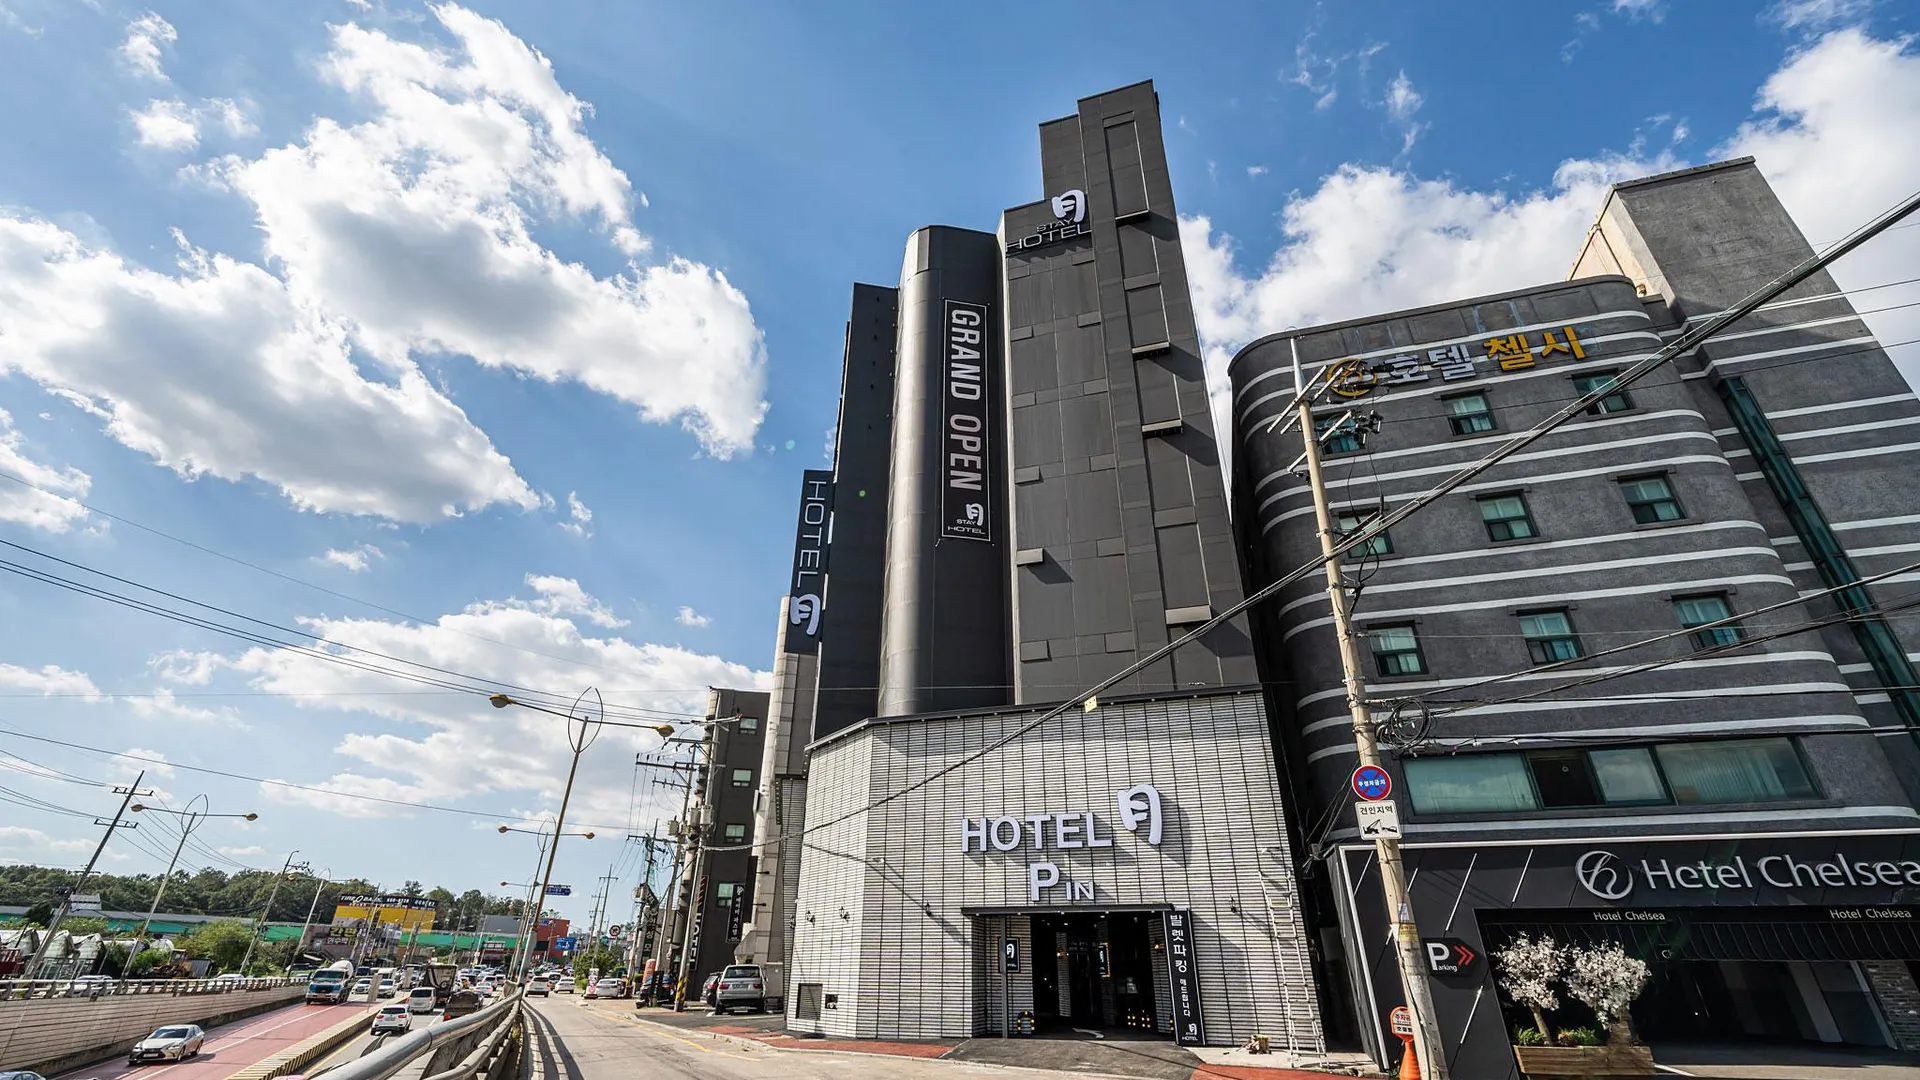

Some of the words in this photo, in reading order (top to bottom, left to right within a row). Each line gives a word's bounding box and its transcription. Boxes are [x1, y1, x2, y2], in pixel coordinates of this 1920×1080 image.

[1005, 223, 1093, 253] HOTEL
[1036, 217, 1074, 232] STAY
[951, 308, 981, 402] GRAND
[1483, 325, 1586, 372] 첼시
[949, 412, 983, 492] OPEN
[798, 479, 827, 589] HOTEL
[947, 525, 986, 535] HOTEL
[1359, 805, 1394, 815] 견인지역
[961, 812, 1113, 853] HOTEL
[1757, 853, 1920, 888] Chelsea
[1593, 911, 1621, 921] Hotel
[1624, 910, 1666, 921] Chelsea
[1829, 908, 1862, 919] Hotel
[1865, 908, 1912, 919] Chelsea
[1169, 914, 1188, 973] 발렛파킹
